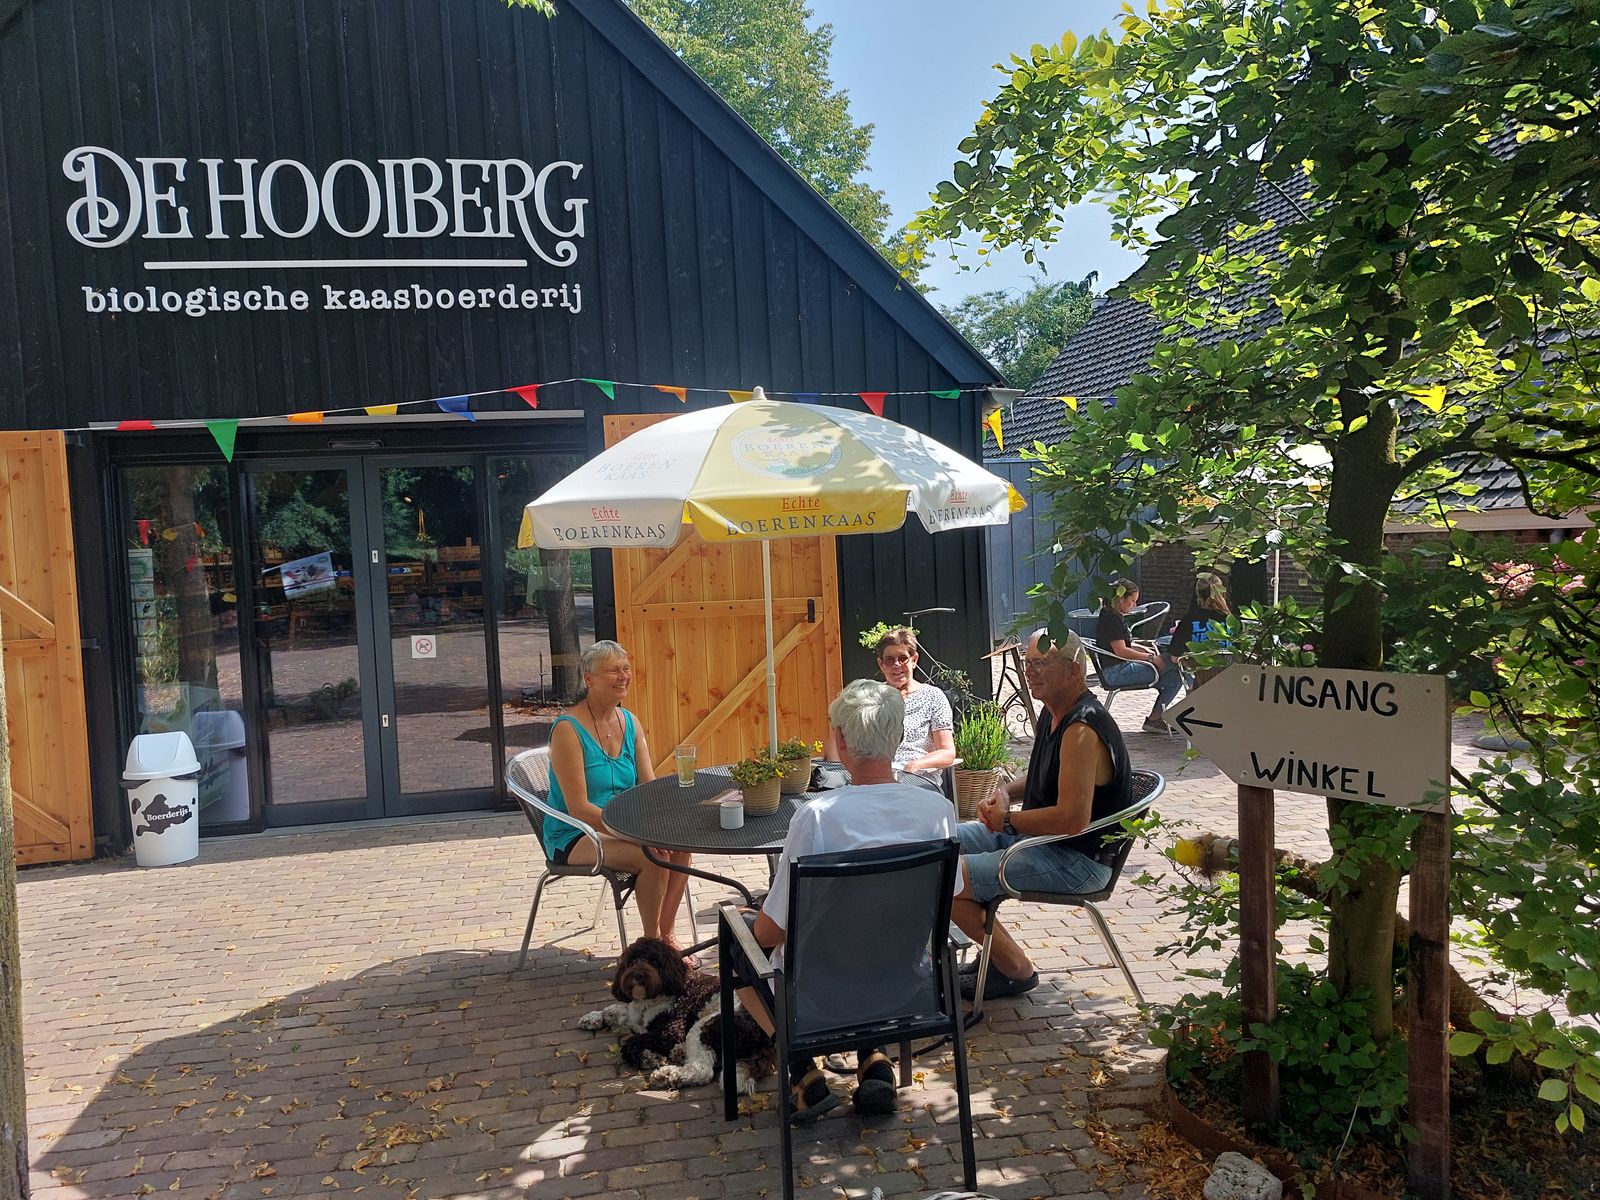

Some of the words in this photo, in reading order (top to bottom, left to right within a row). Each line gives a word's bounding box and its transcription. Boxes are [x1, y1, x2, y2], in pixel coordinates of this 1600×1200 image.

[62, 145, 194, 249] DE
[199, 157, 589, 267] HOOIBERG
[82, 286, 309, 317] biologische
[323, 283, 582, 313] kaasboerderij
[592, 506, 621, 520] Echte
[781, 496, 820, 510] Echte
[726, 511, 877, 536] BOERENKAAS
[928, 504, 995, 525] BERENKAAS
[146, 807, 189, 821] Boerderijs
